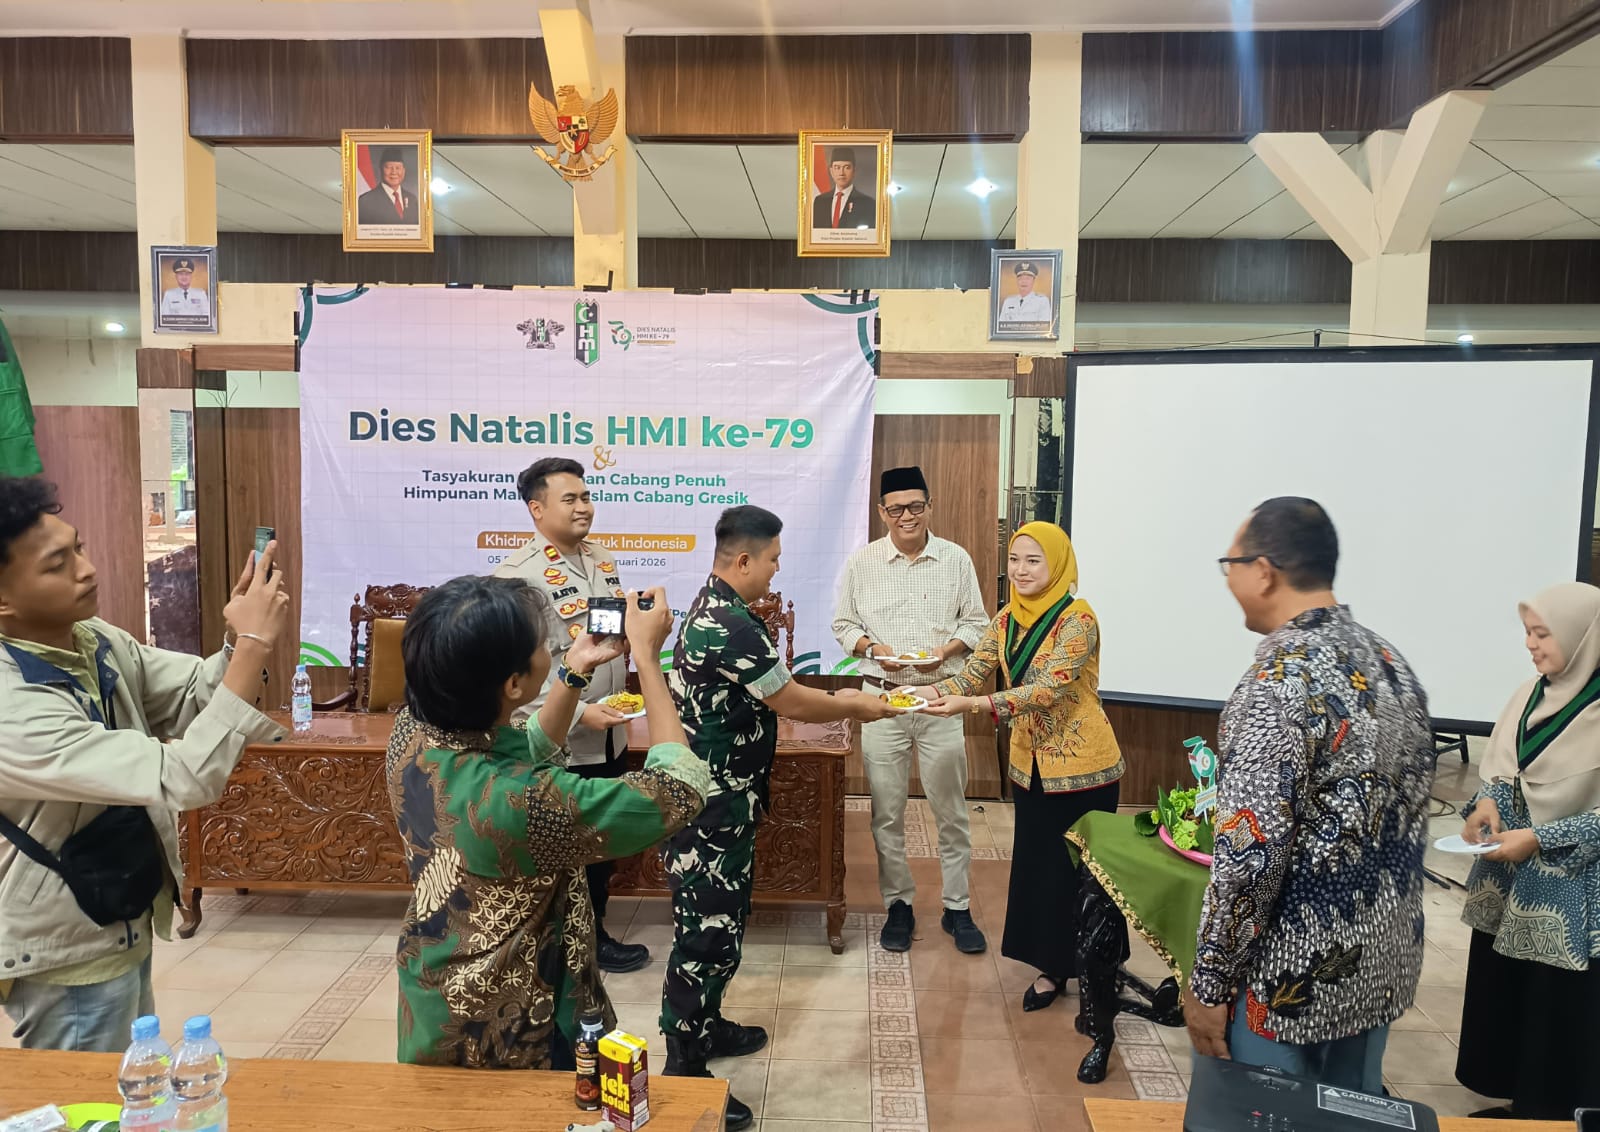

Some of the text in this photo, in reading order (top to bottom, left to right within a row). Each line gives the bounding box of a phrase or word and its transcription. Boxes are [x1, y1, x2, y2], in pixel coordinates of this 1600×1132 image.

[350, 408, 814, 448] Dies Natalis HMI ke-79
[422, 470, 514, 485] Tasyakuran
[610, 473, 670, 488] Cabang
[675, 475, 726, 487] Penuh
[404, 487, 488, 501] Himpunan
[591, 490, 629, 502] slam
[633, 491, 693, 506] Cabang
[698, 492, 748, 504] Gresik
[485, 534, 530, 546] Khidm
[622, 537, 688, 549] Indonesia
[488, 556, 501, 564] 05
[616, 558, 638, 566] ruari
[640, 559, 666, 567] 2026
[600, 1072, 629, 1100] teh
[1341, 1091, 1387, 1107] CAUTION
